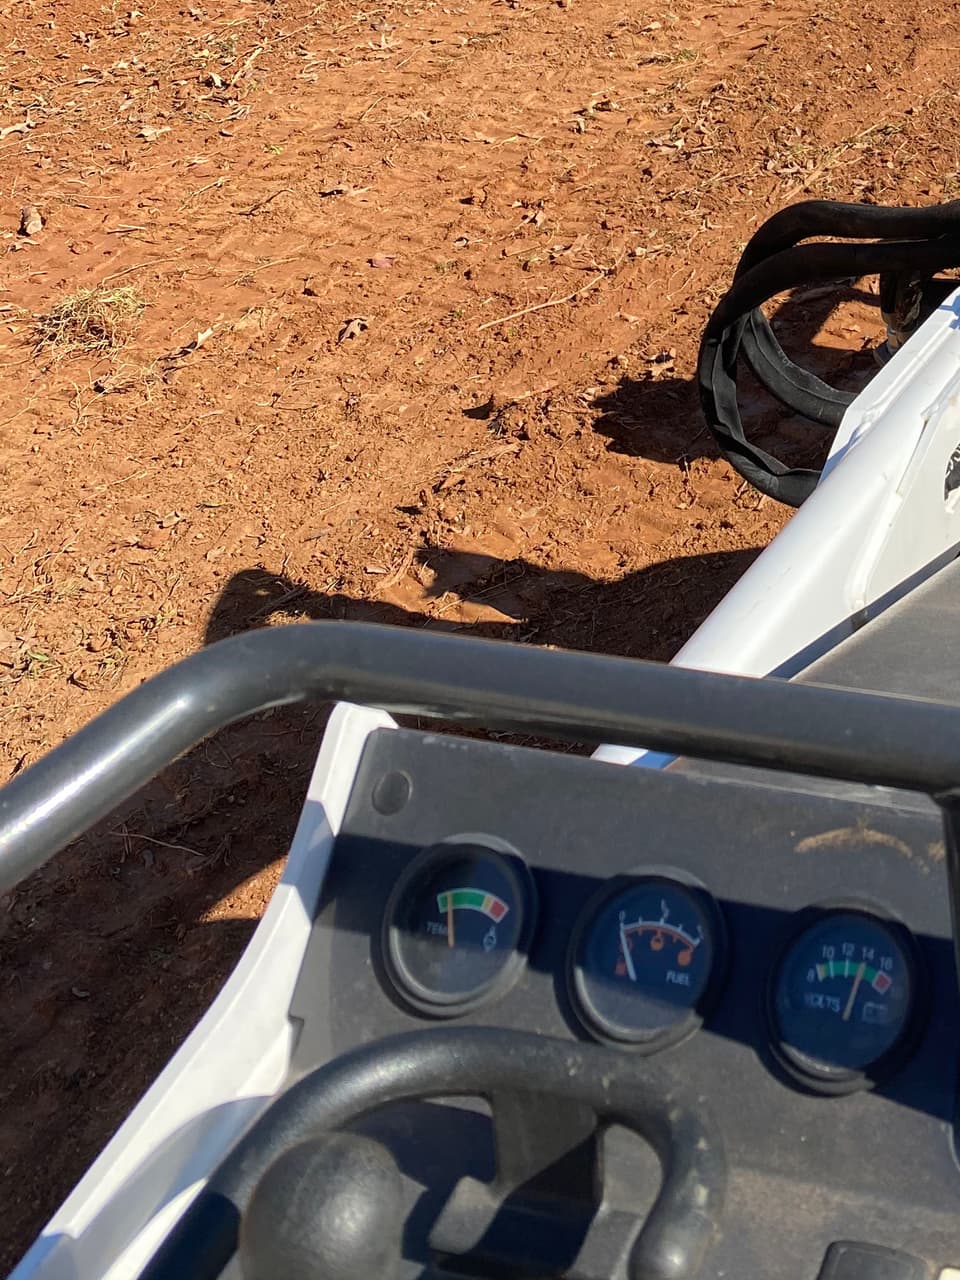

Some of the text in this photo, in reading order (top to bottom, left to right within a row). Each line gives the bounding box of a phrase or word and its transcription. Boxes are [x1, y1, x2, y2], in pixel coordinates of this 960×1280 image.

[822, 945, 836, 960] 10
[842, 942, 856, 957] 12
[862, 946, 875, 960] 14
[666, 970, 690, 987] FUEL
[803, 992, 841, 1013] VOLTS
